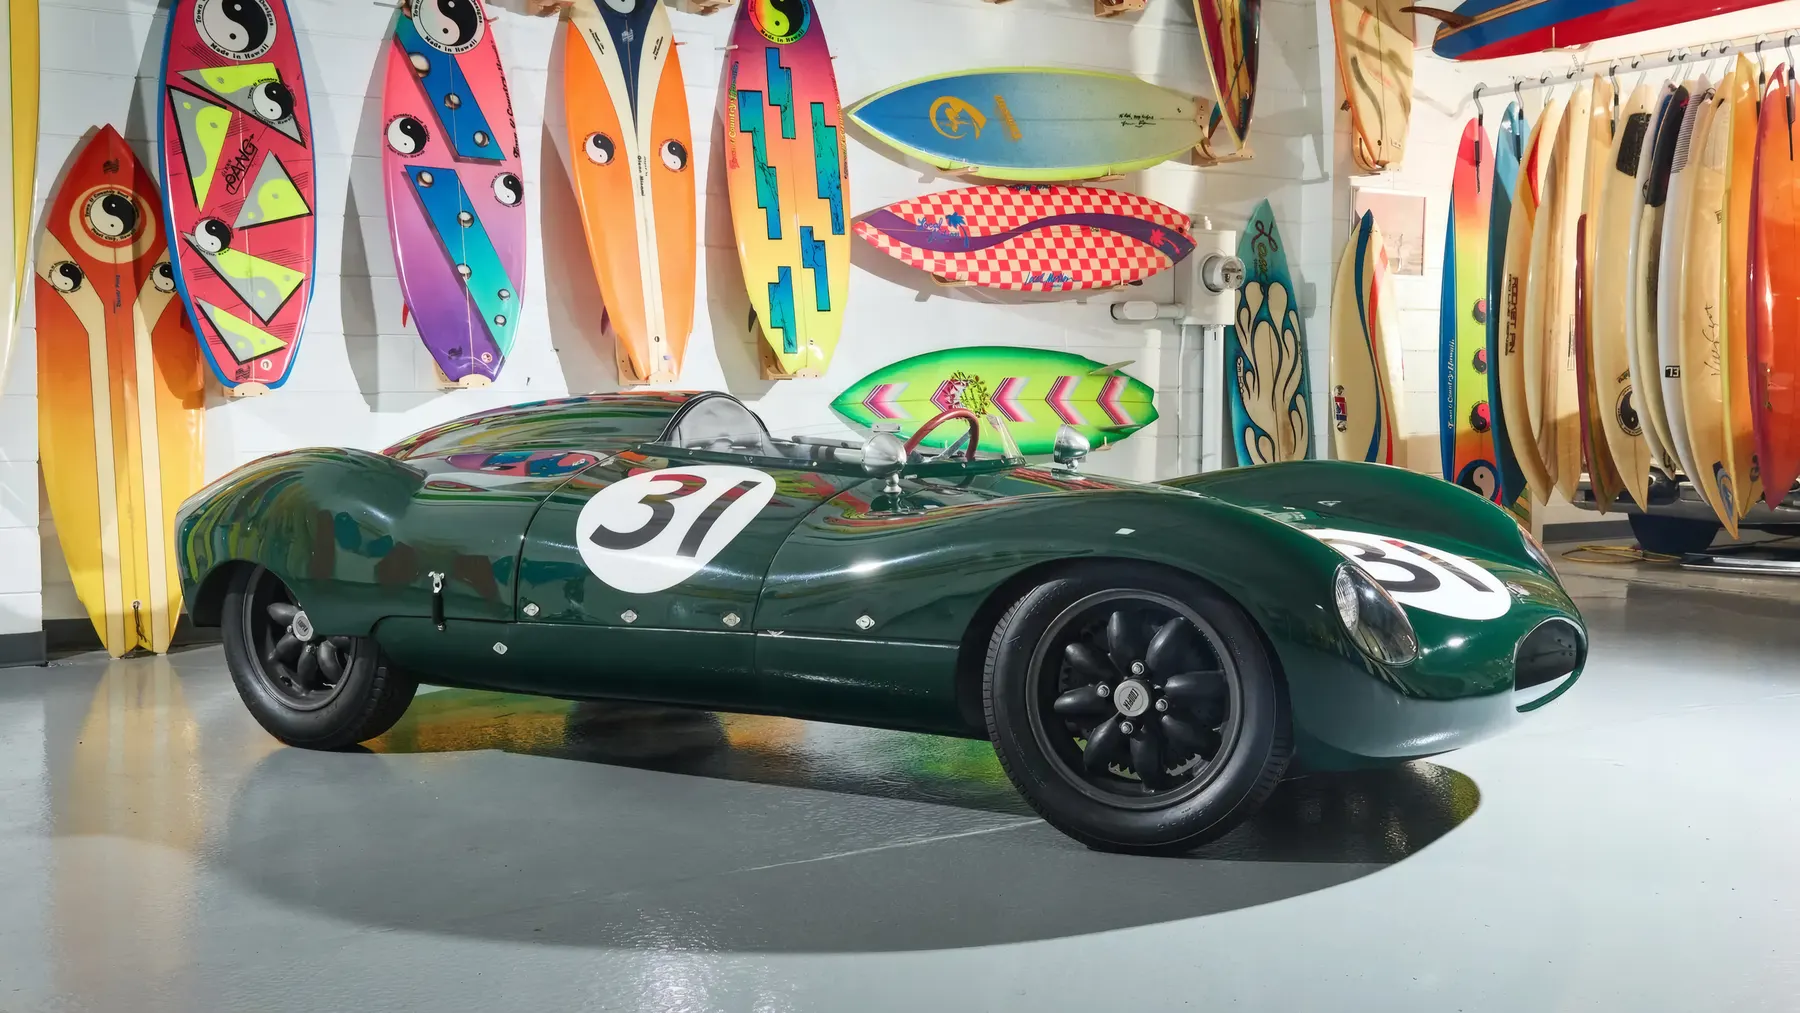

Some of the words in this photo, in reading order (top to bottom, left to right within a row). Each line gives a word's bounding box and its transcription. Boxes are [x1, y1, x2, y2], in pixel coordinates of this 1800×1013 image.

[424, 35, 442, 50] Made
[454, 39, 479, 53] Hawaii
[760, 29, 775, 40] Made
[785, 29, 805, 43] Hawaii
[210, 42, 230, 57] Made
[244, 43, 269, 59] Hawaii
[225, 138, 256, 191] PANG
[916, 216, 943, 231] Local
[1024, 271, 1046, 286] Local
[1510, 277, 1518, 329] ROCKET
[590, 474, 763, 558] 31
[1321, 537, 1495, 593] 31
